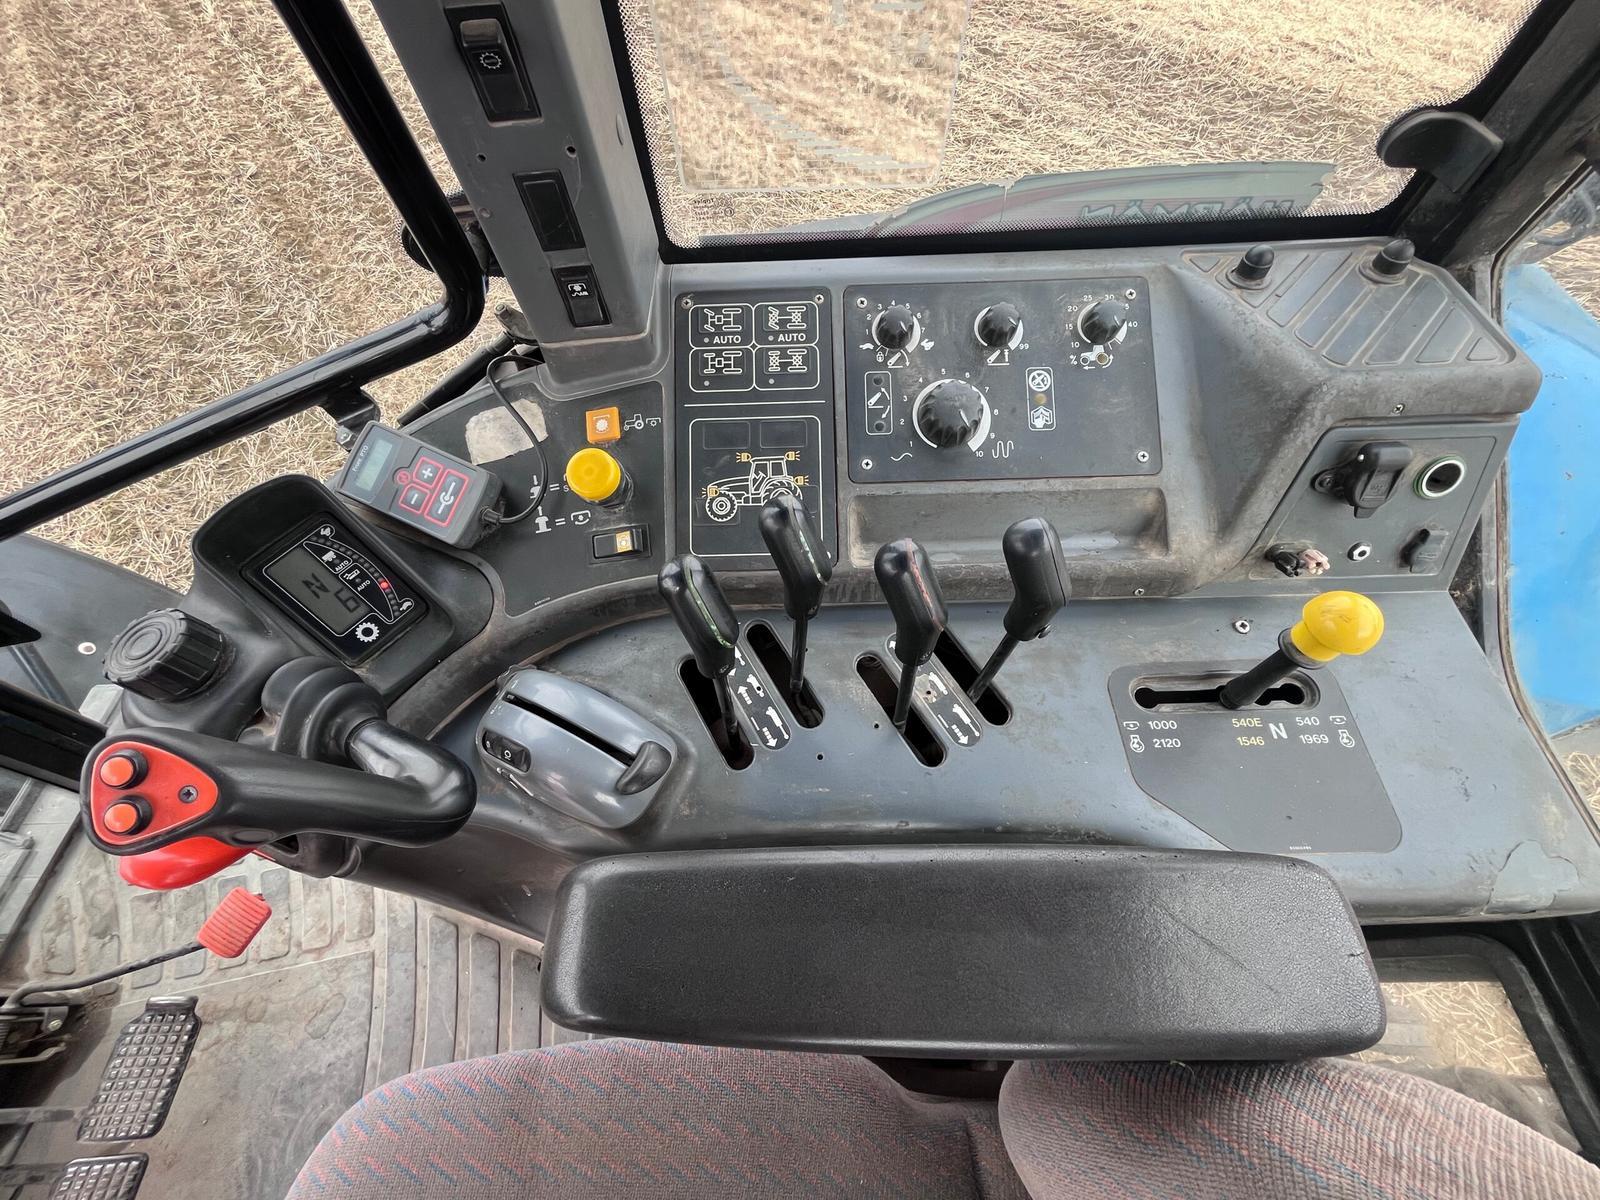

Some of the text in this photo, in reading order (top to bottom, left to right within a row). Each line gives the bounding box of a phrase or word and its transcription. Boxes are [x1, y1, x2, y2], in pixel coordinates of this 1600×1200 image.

[713, 335, 741, 345] AUTO
[778, 332, 806, 342] AUTO
[335, 560, 349, 572] AUTO
[357, 579, 371, 591] AUTO
[1148, 716, 1320, 730] 1000 540E 540
[1268, 722, 1288, 740] N
[1152, 733, 1329, 749] 2120 1546 1969
